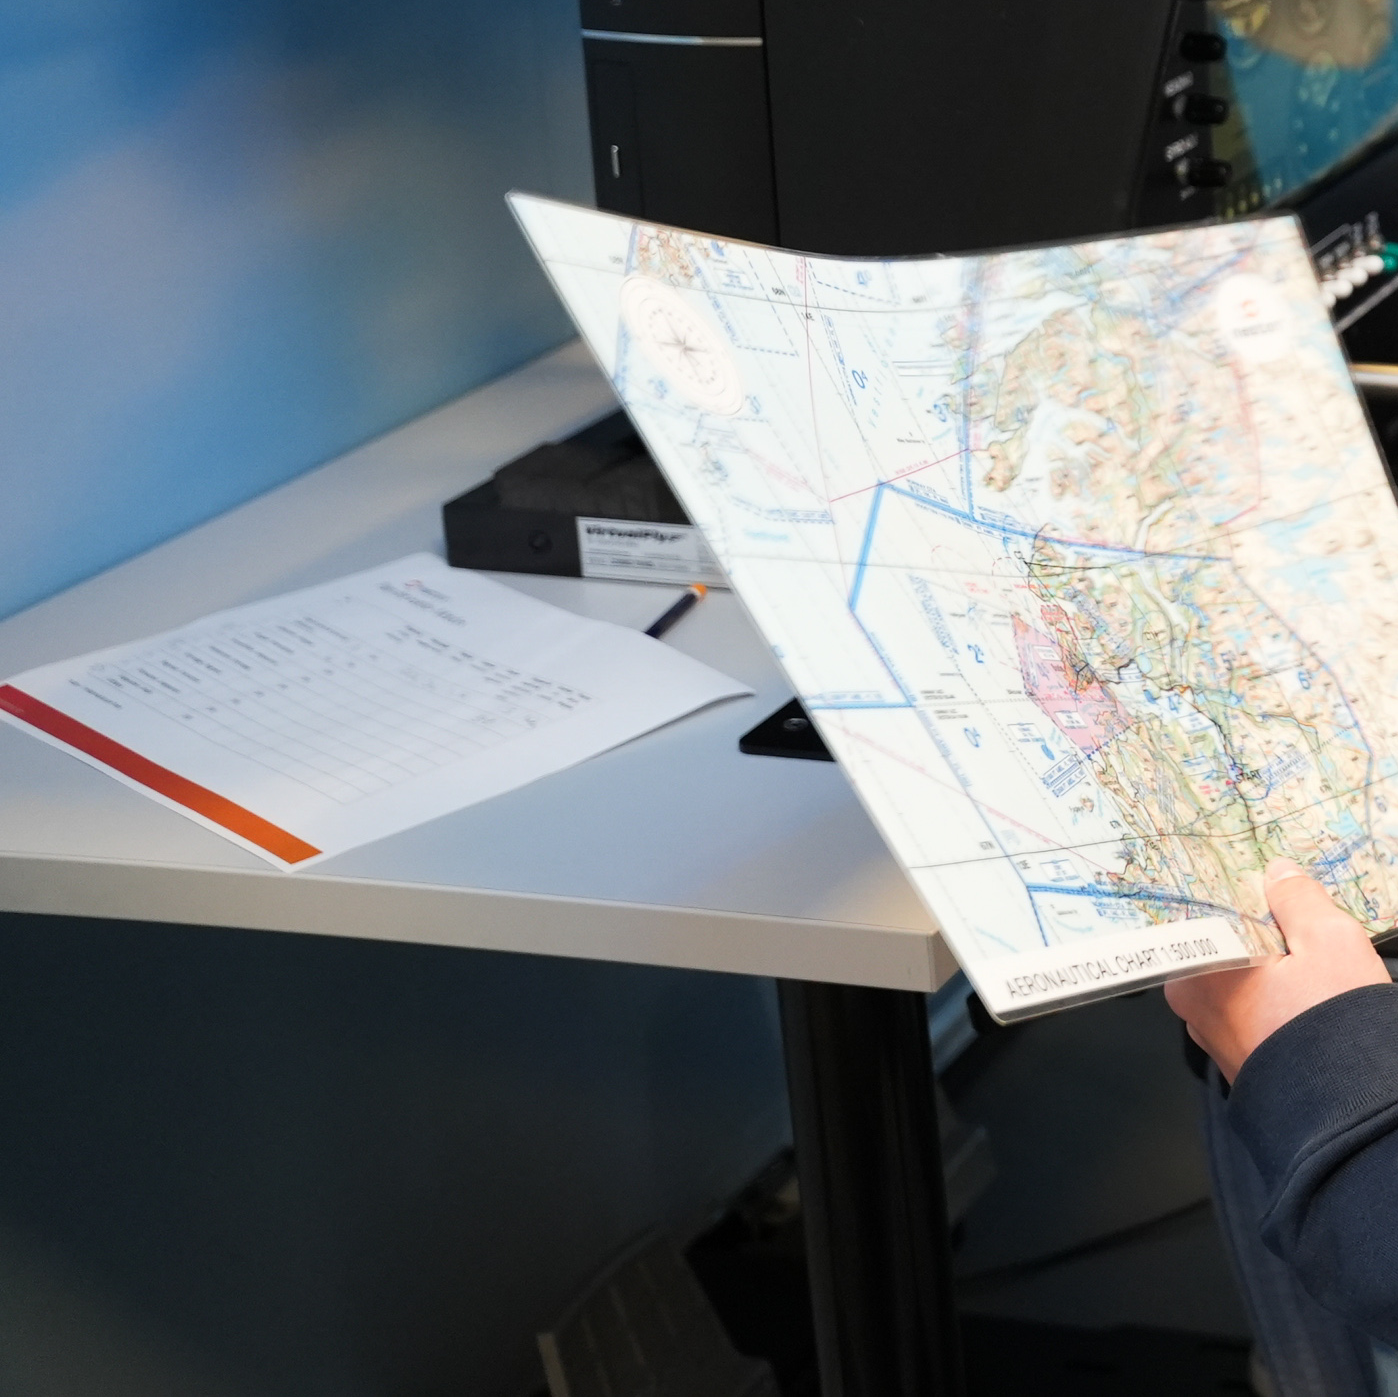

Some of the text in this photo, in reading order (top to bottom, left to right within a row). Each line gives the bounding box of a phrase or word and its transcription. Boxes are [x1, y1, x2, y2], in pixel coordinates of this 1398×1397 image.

[1236, 768, 1262, 783] START
[1005, 937, 1219, 999] AERONAUTICAL CHART 1:500 000
